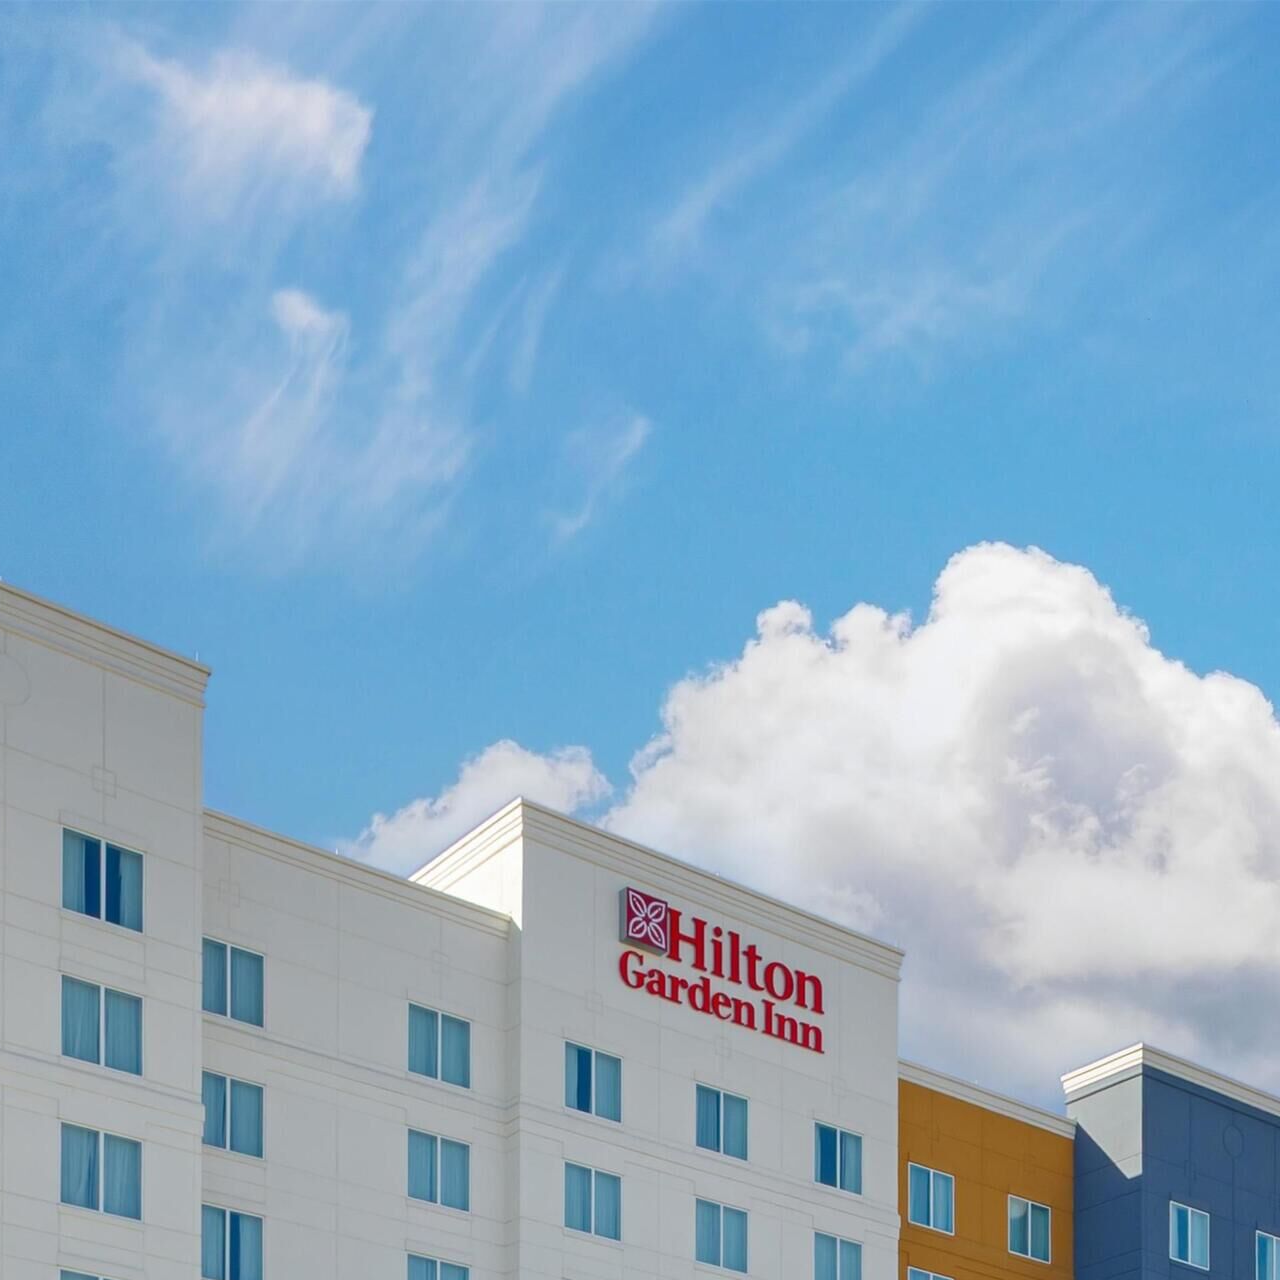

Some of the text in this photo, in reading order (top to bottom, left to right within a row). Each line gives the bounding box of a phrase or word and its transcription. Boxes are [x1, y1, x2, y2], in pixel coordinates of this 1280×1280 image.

[619, 950, 824, 1054] Garden Inn
[667, 907, 824, 1014] Hilton
